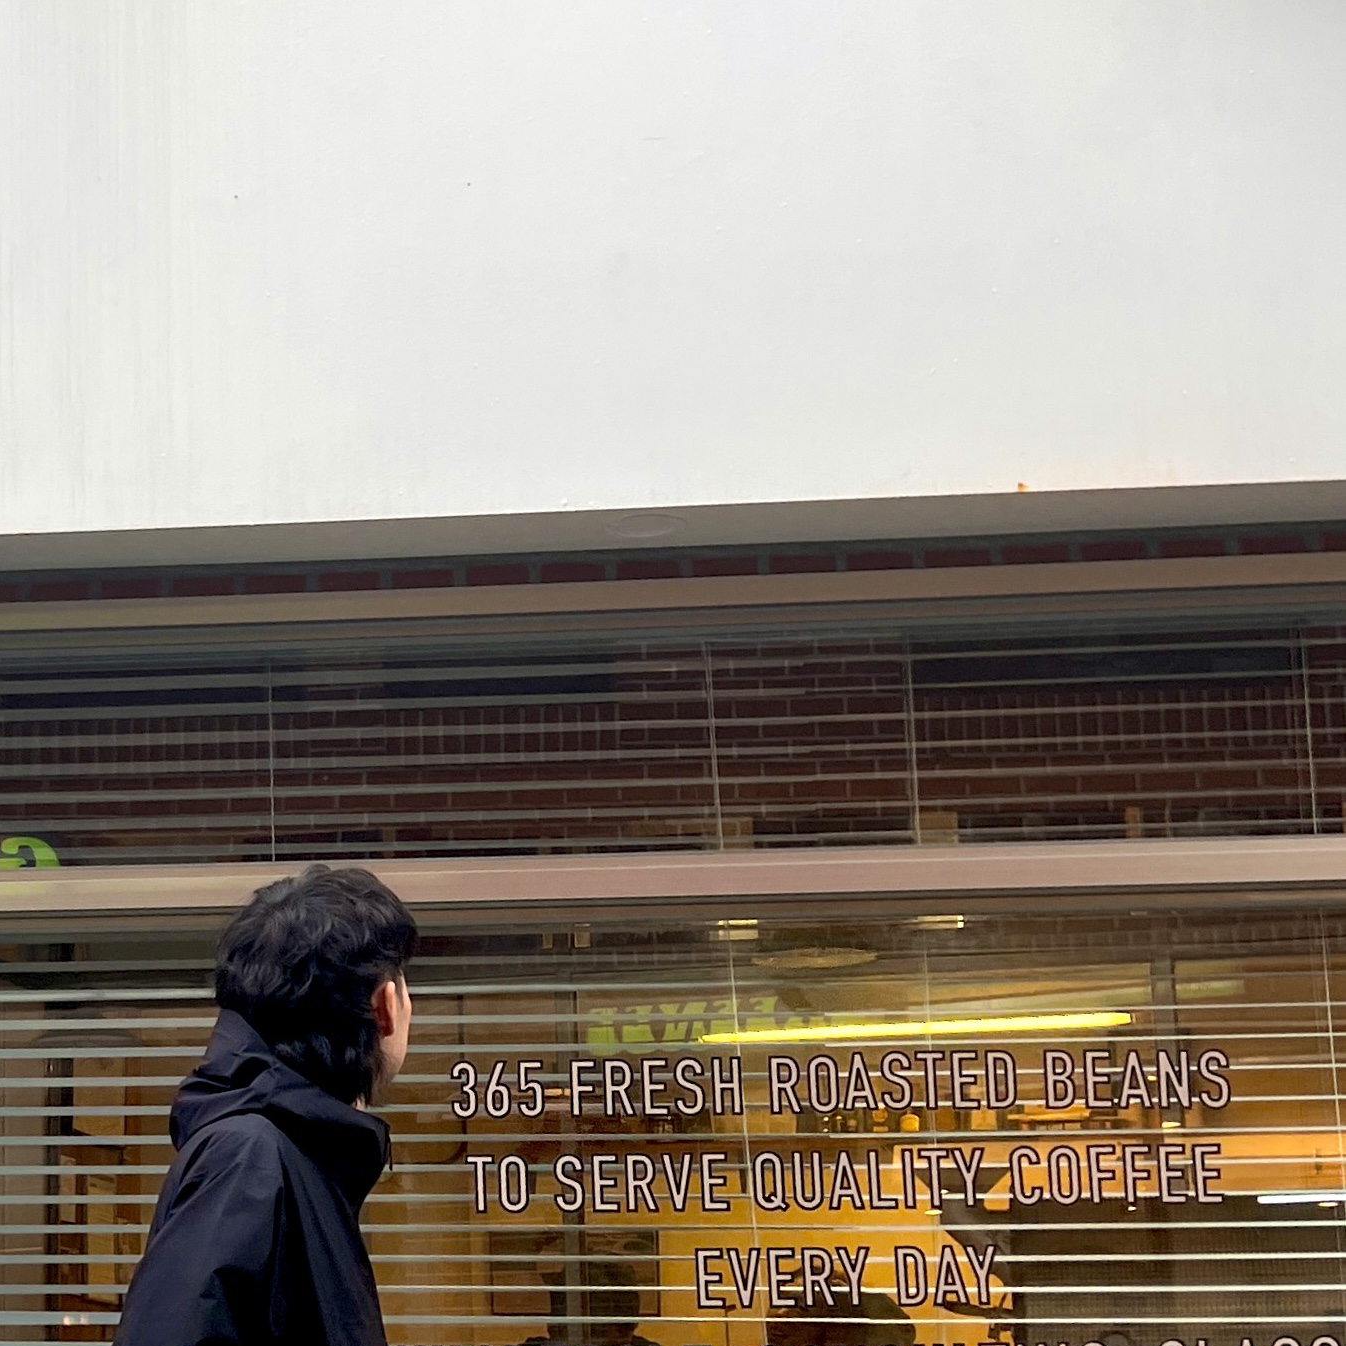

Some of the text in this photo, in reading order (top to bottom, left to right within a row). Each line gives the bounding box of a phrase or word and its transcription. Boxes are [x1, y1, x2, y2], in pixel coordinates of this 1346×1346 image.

[451, 1048, 1232, 1118] 365 FRESH ROASTED BEANS
[466, 1143, 1225, 1215] TO SERVE QUALITY COFFEE
[696, 1245, 997, 1309] EVERY DAY
